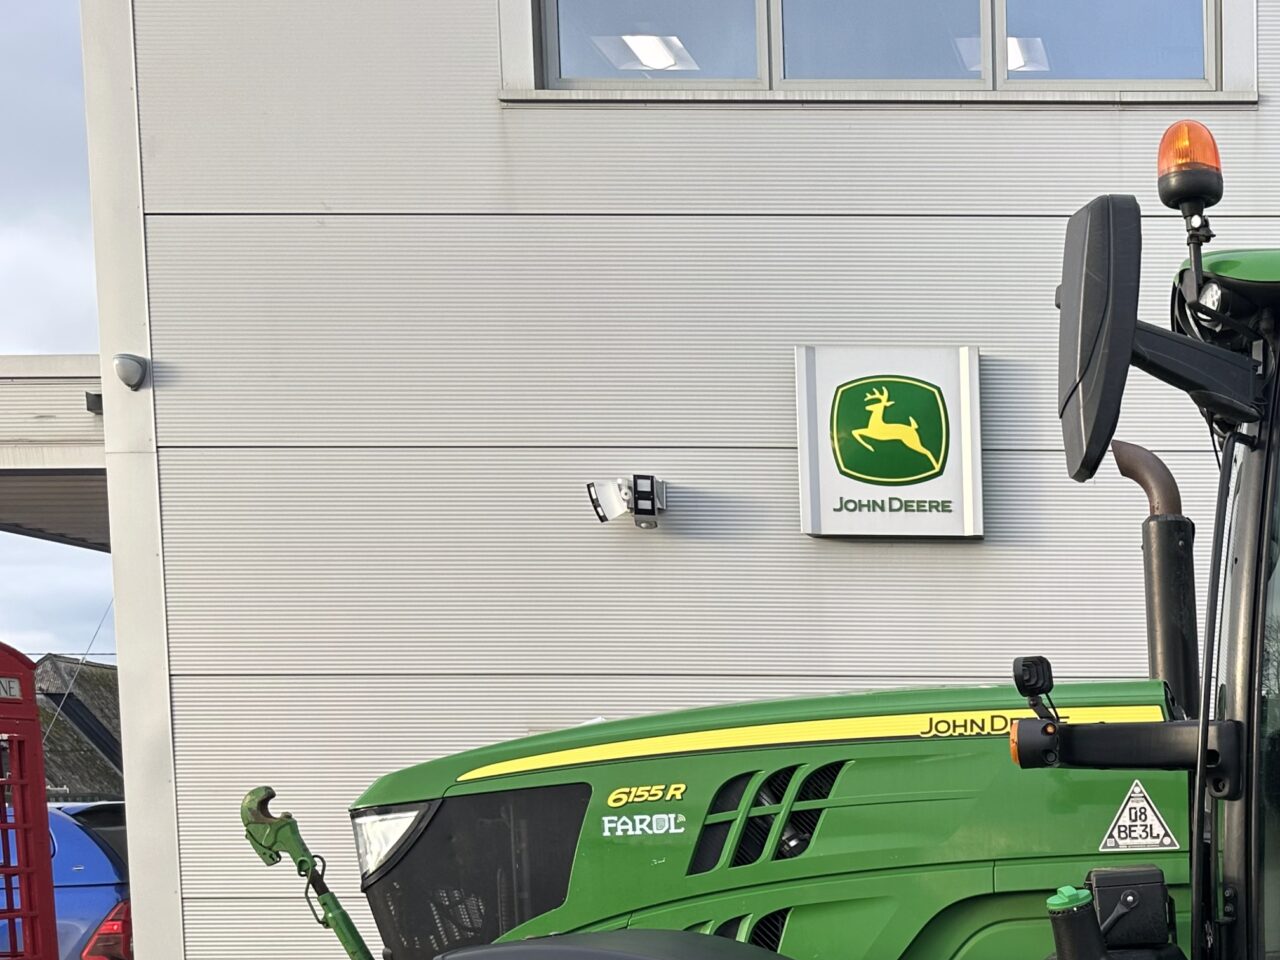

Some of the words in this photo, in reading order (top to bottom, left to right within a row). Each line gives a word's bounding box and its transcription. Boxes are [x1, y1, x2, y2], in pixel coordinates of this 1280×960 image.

[833, 497, 885, 513] JOHN
[889, 497, 953, 513] DEERE
[920, 717, 985, 735] JOHN
[602, 813, 685, 836] FAROL
[1117, 824, 1160, 840] BE3L
